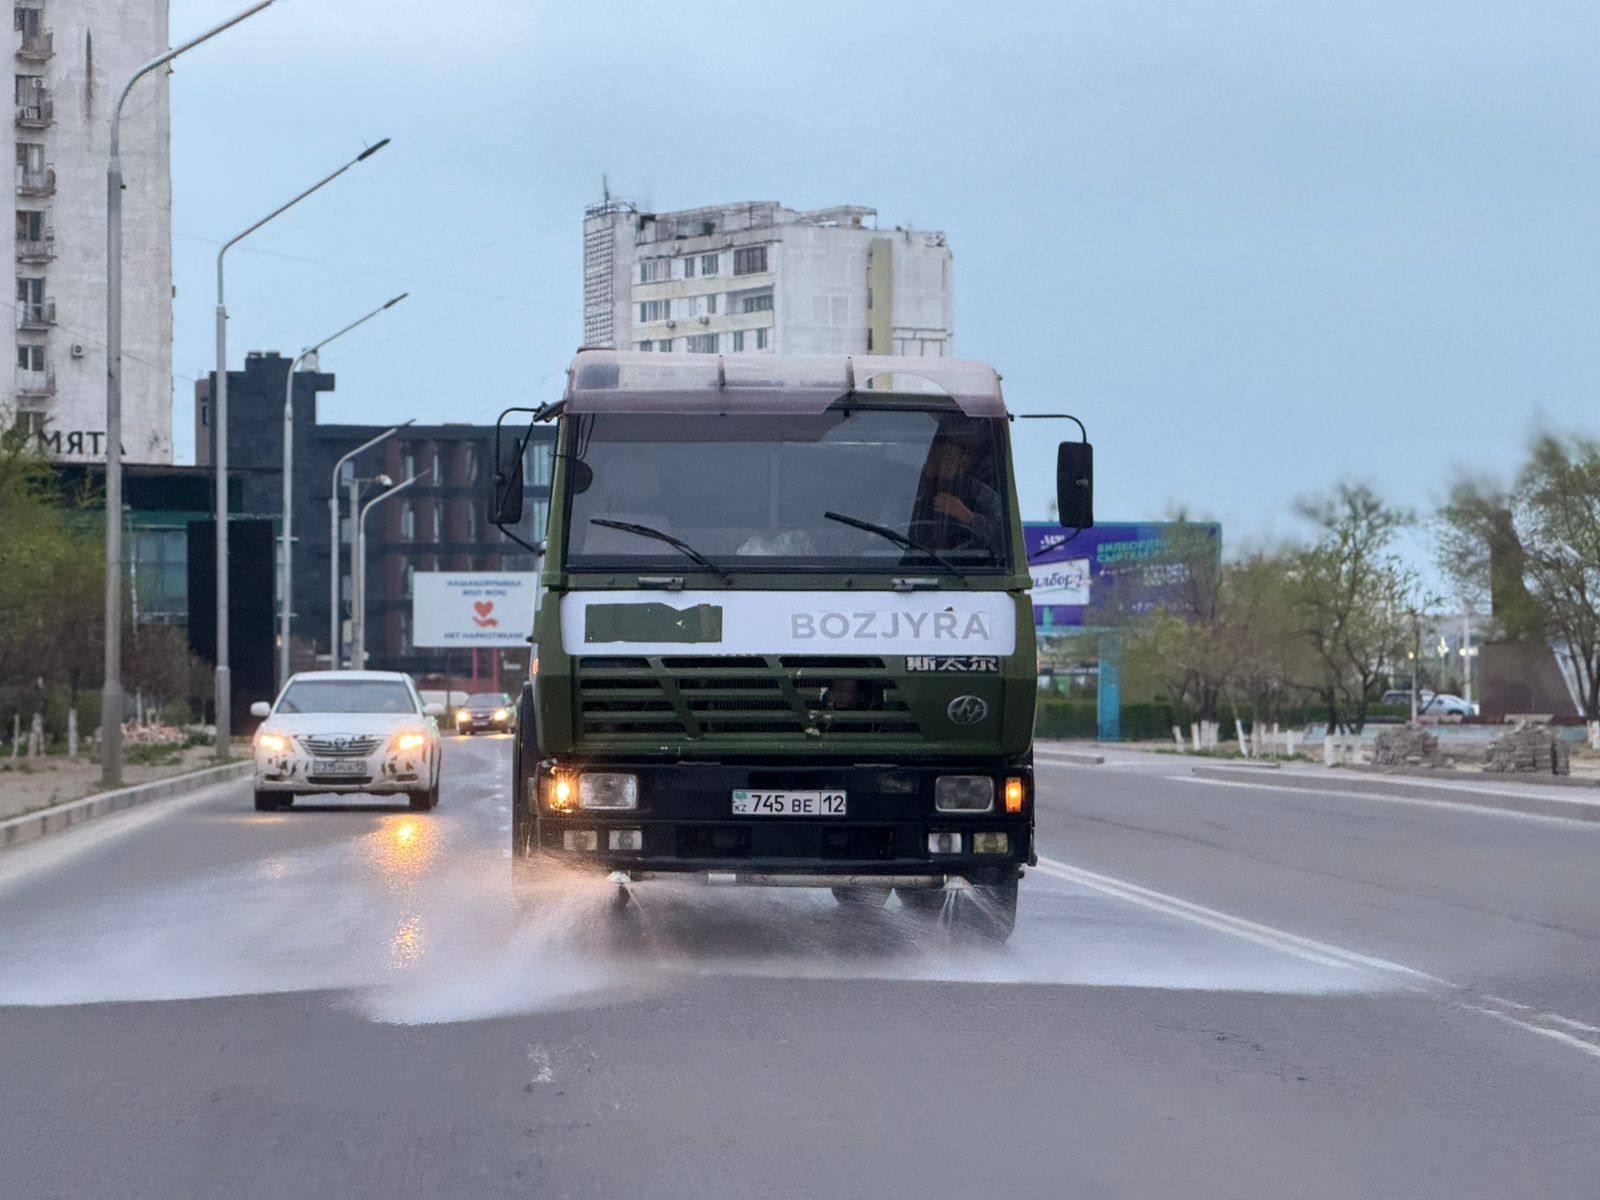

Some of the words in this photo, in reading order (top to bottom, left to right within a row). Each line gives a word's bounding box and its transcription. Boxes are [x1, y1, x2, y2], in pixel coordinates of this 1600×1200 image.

[791, 611, 989, 640] BOZJYRA
[906, 656, 998, 671] 斯太尔
[735, 804, 747, 812] KZ
[751, 794, 785, 813] 745
[792, 799, 813, 813] BE
[823, 795, 844, 813] 12
